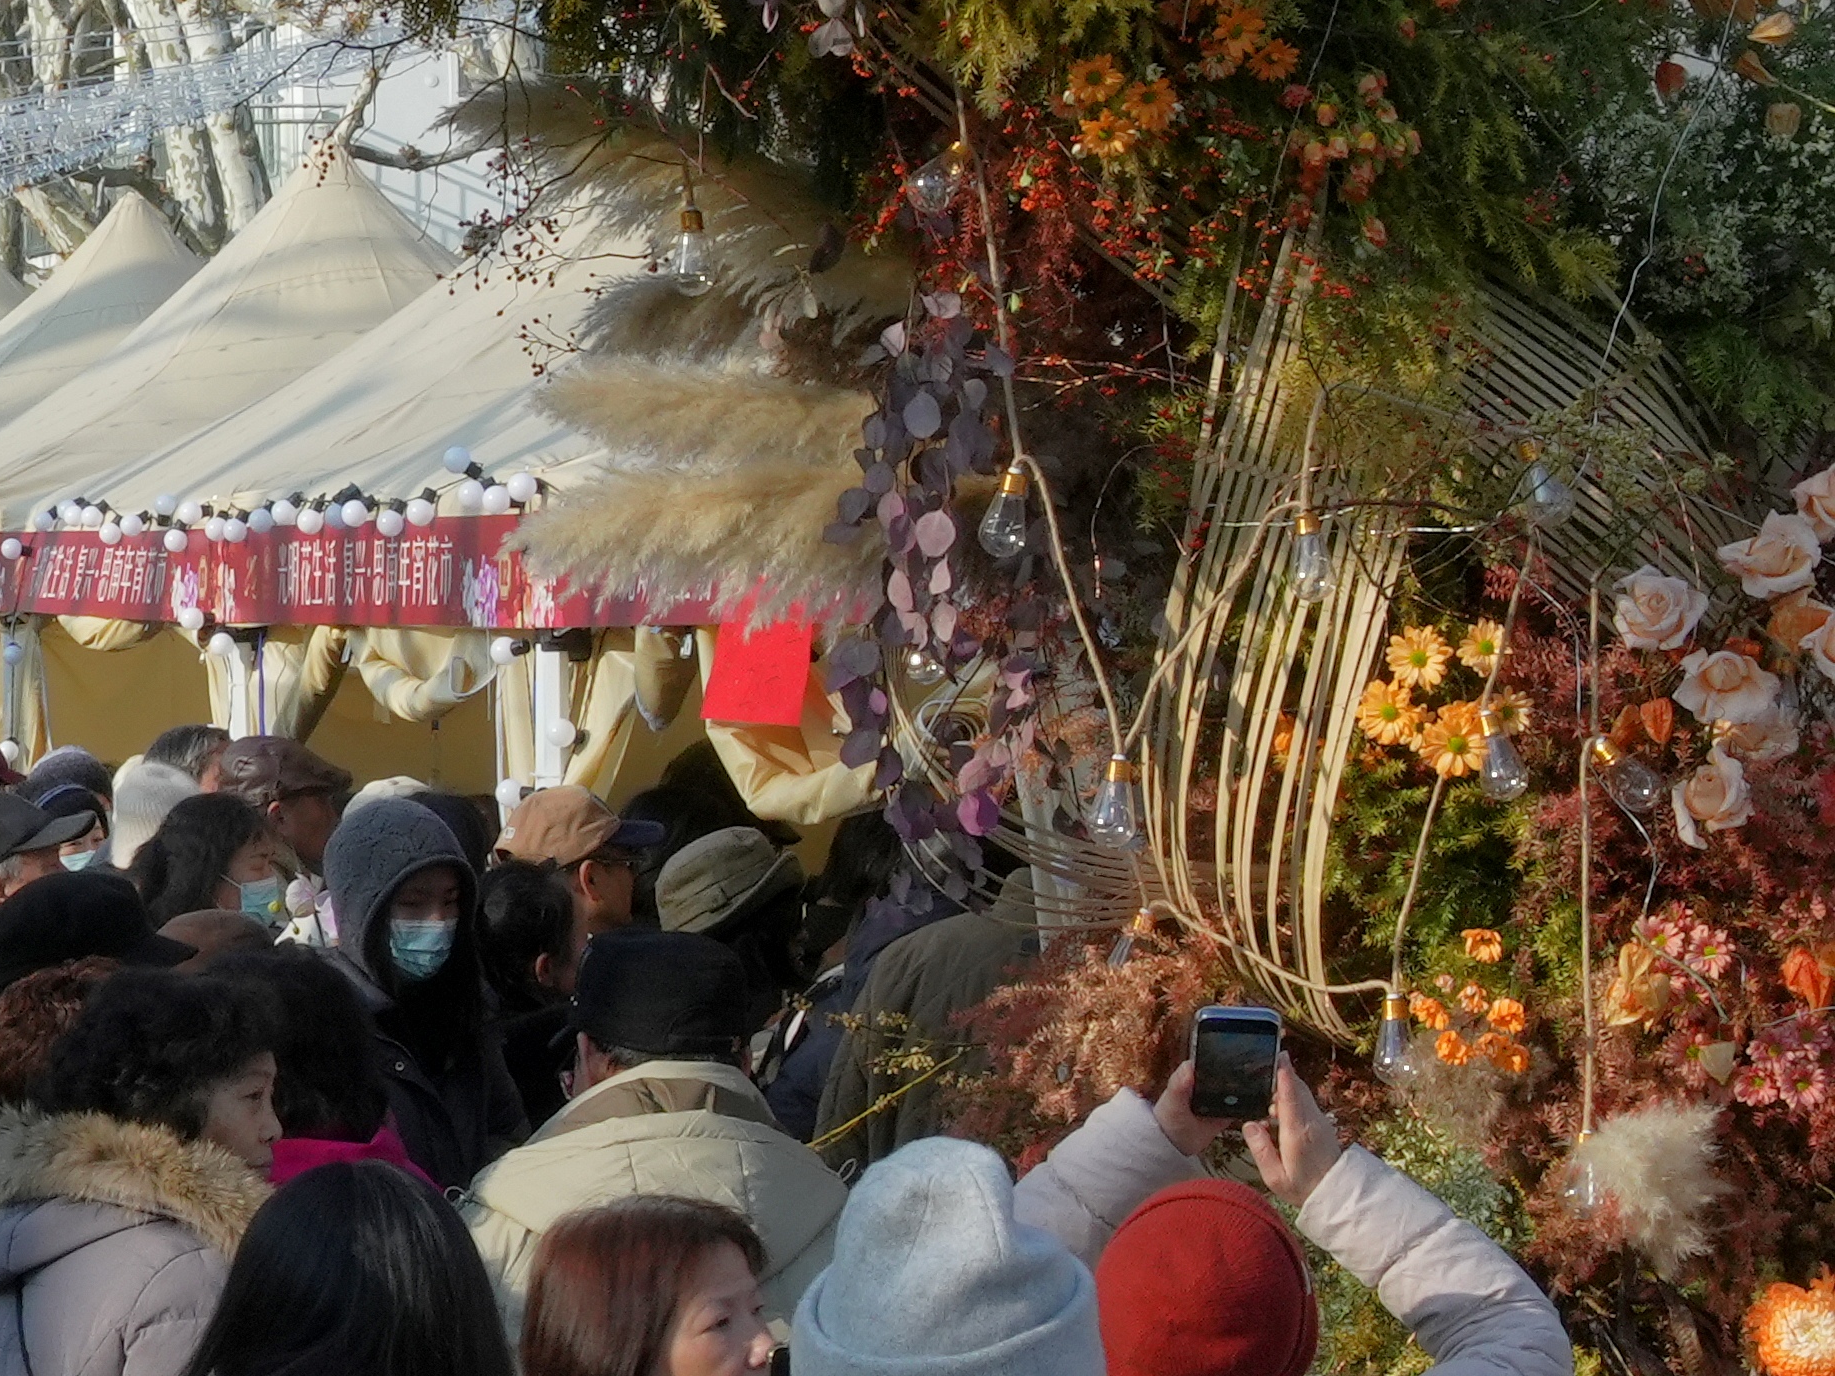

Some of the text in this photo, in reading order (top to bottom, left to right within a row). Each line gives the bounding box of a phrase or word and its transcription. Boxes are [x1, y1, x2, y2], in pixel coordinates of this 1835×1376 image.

[277, 538, 337, 609] 光明花生活
